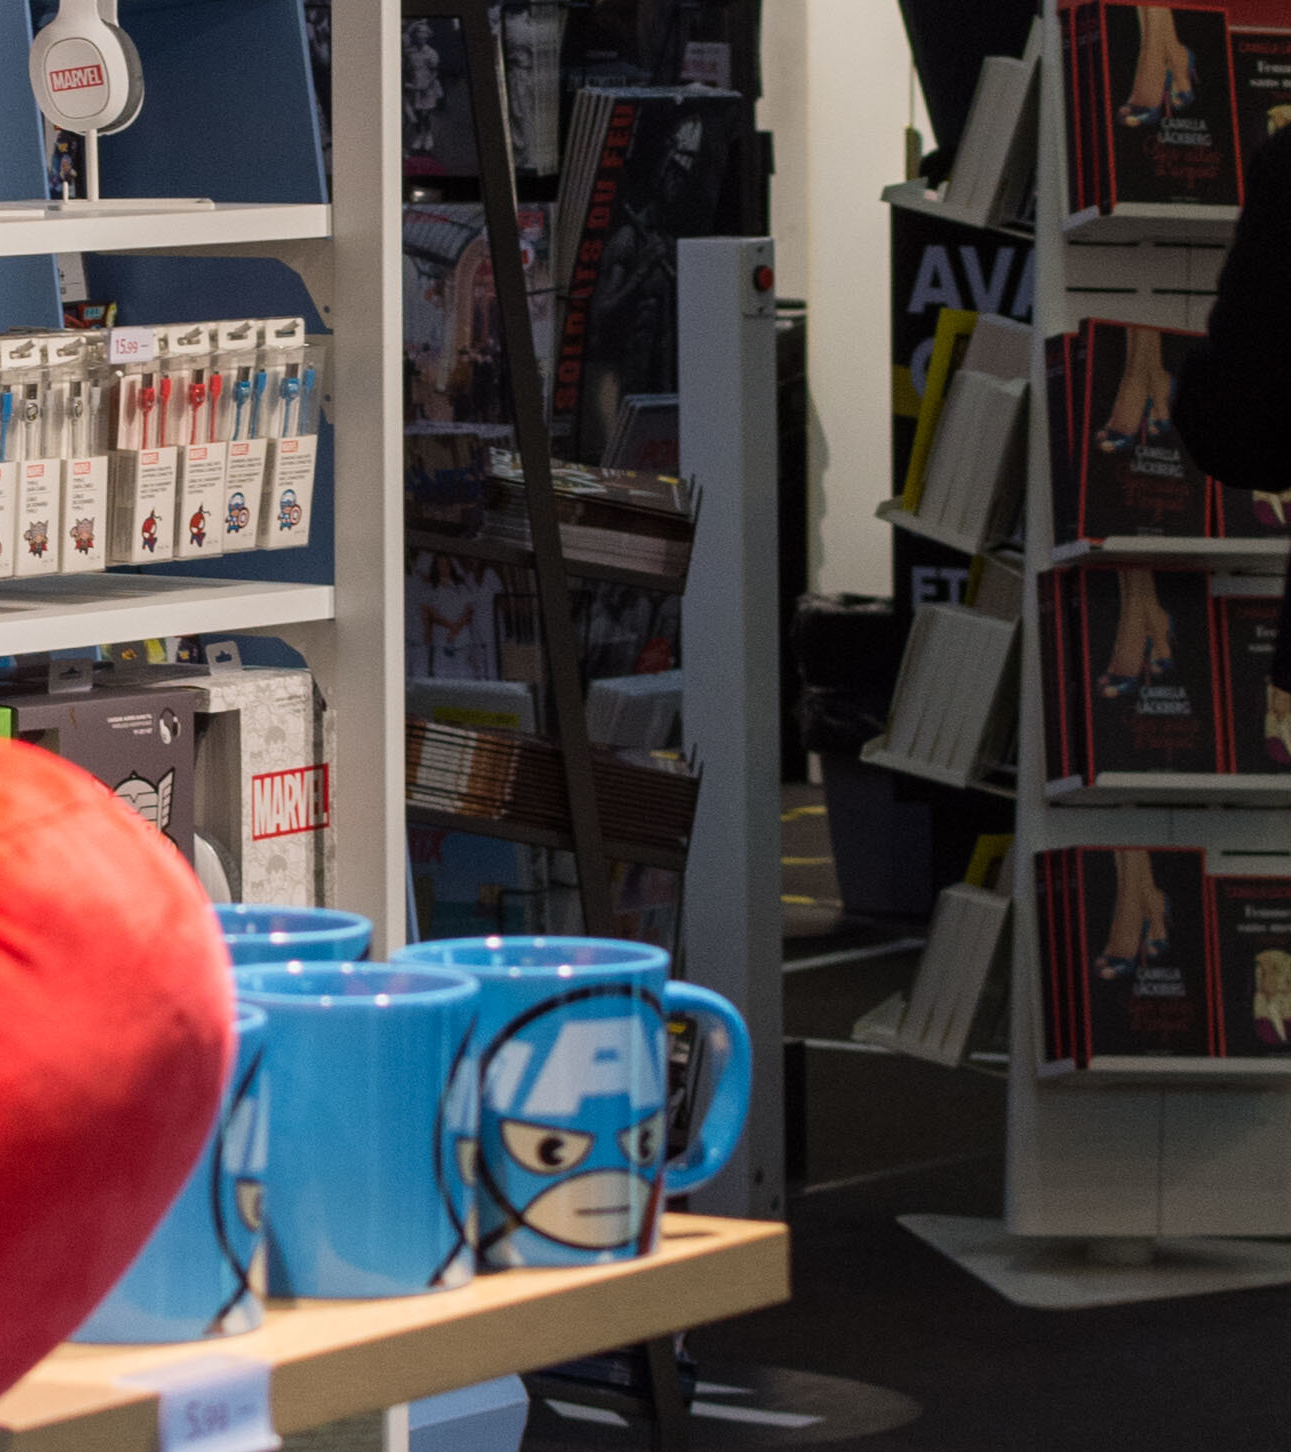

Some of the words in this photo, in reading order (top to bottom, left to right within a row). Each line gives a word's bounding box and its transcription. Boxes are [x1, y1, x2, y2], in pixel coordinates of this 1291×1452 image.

[51, 65, 103, 91] MARVEL
[115, 339, 138, 355] 15.99
[253, 765, 327, 839] MARVEL
